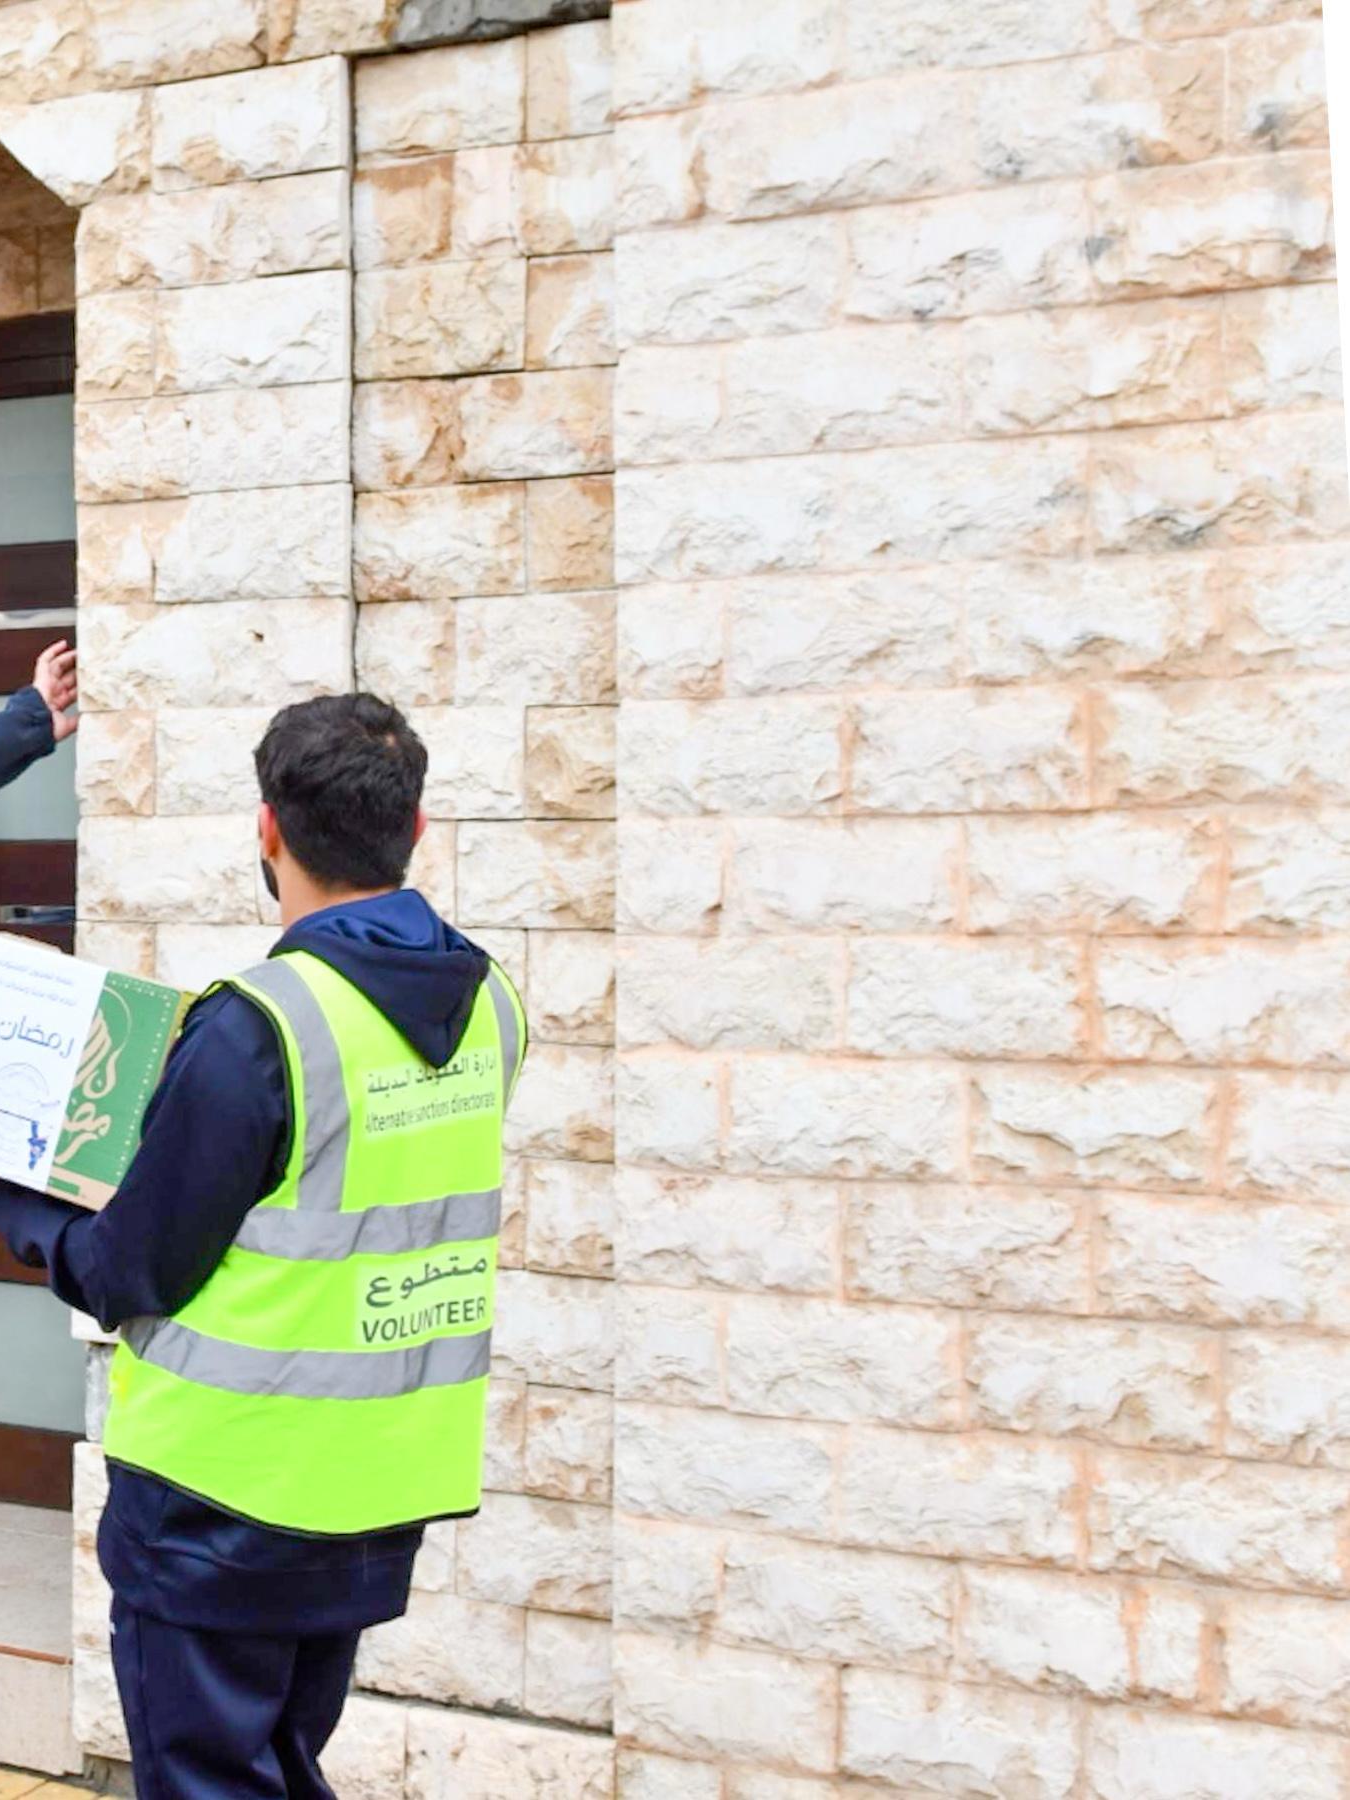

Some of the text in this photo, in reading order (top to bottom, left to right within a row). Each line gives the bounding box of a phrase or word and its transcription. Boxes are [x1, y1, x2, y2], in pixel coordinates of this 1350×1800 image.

[367, 1068, 411, 1098] لبديلة
[365, 1255, 488, 1308] متطوع
[362, 1296, 487, 1344] VOLUNTEER
